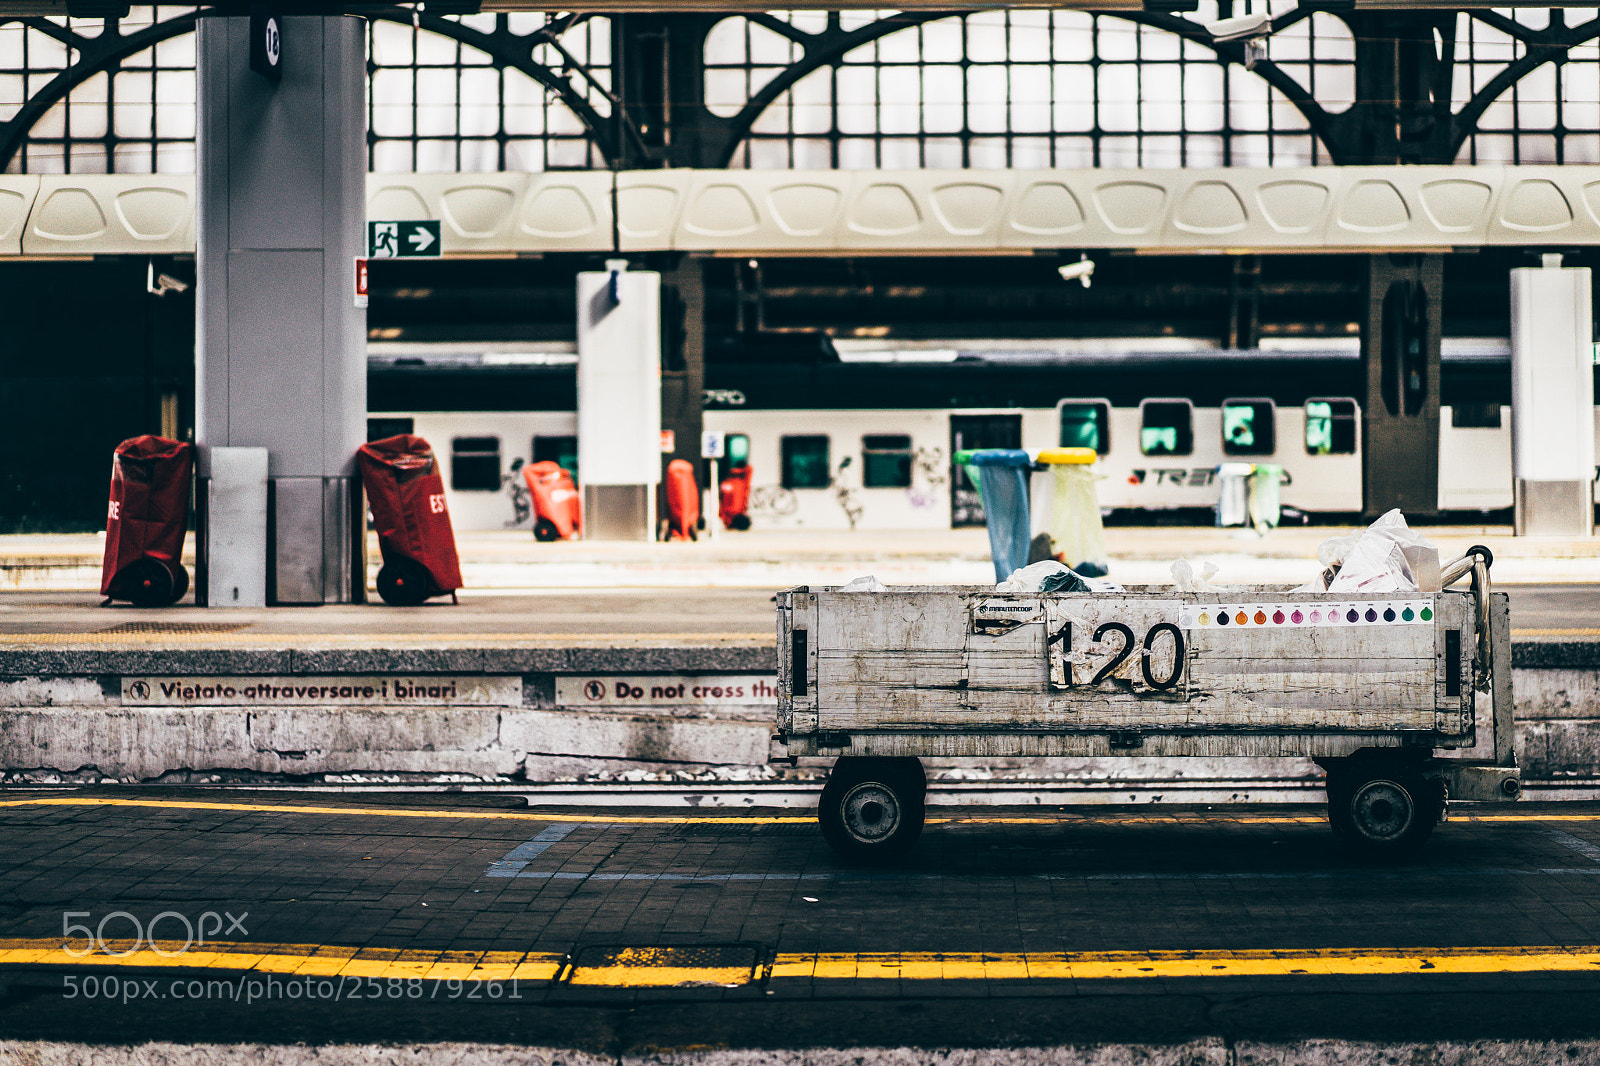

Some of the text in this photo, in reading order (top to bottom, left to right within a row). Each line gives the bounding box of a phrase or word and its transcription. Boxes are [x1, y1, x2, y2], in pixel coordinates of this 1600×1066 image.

[267, 27, 279, 55] 18
[1048, 621, 1185, 691] 120
[159, 680, 457, 699] Vietato attraversare i binari
[615, 681, 645, 699] Do
[651, 683, 686, 699] not
[692, 685, 745, 699] cross
